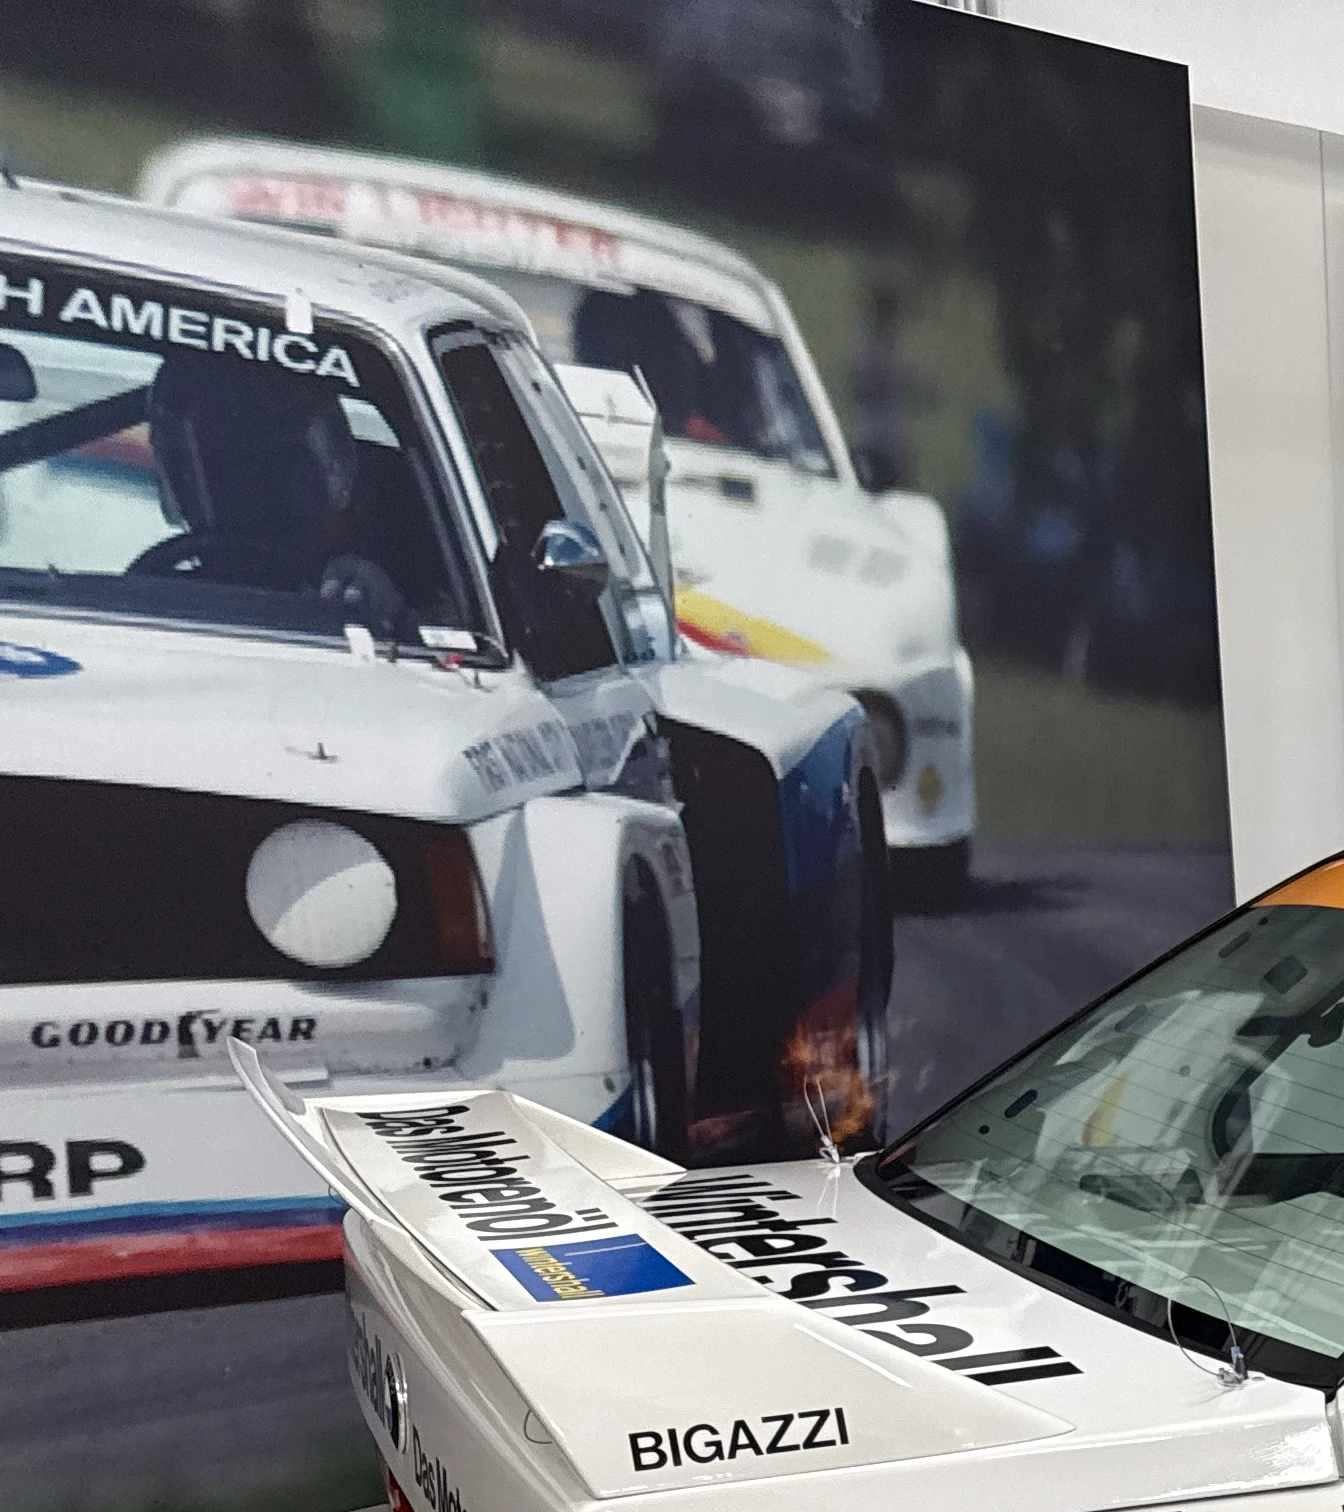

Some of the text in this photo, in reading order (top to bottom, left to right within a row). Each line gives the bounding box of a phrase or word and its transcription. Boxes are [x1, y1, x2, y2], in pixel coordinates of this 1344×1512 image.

[59, 287, 361, 388] AMERICA
[30, 1013, 317, 1052] GOODYEAR
[355, 1105, 620, 1242] Das Motorenöl
[513, 1246, 607, 1300] wintershall
[412, 1423, 436, 1510] Das
[628, 1407, 850, 1472] BIGAZZI
